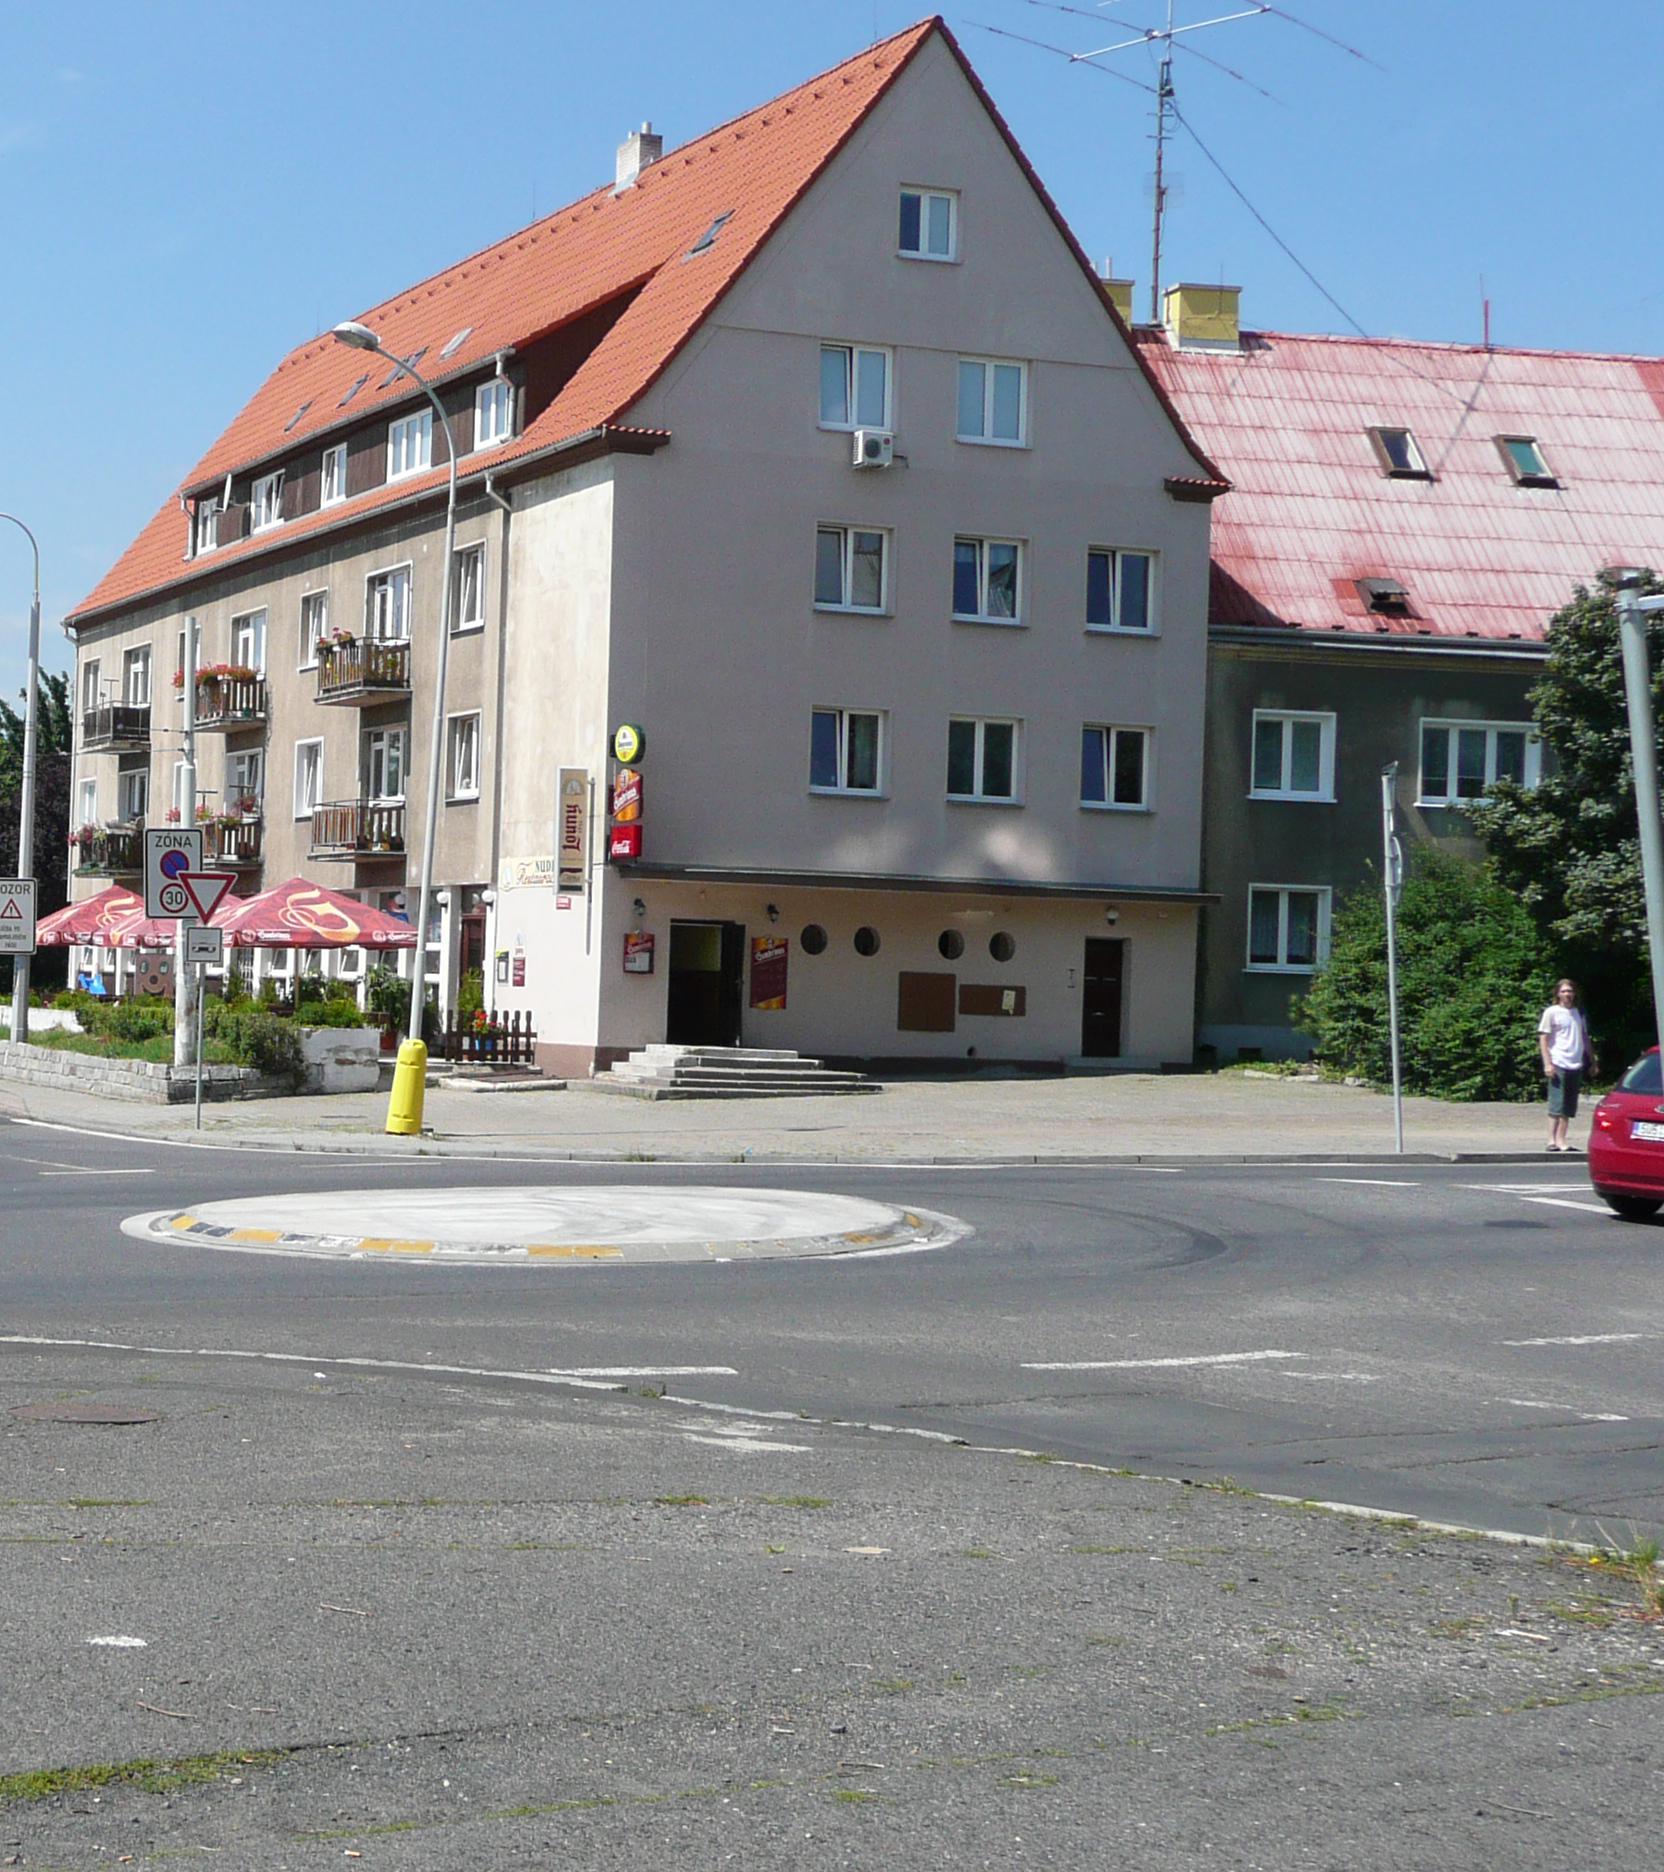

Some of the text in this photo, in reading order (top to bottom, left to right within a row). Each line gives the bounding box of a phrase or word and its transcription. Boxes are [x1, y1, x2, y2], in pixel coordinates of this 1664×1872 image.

[562, 803, 582, 851] Louny
[155, 833, 193, 848] ZÓNA
[165, 891, 183, 905] 30
